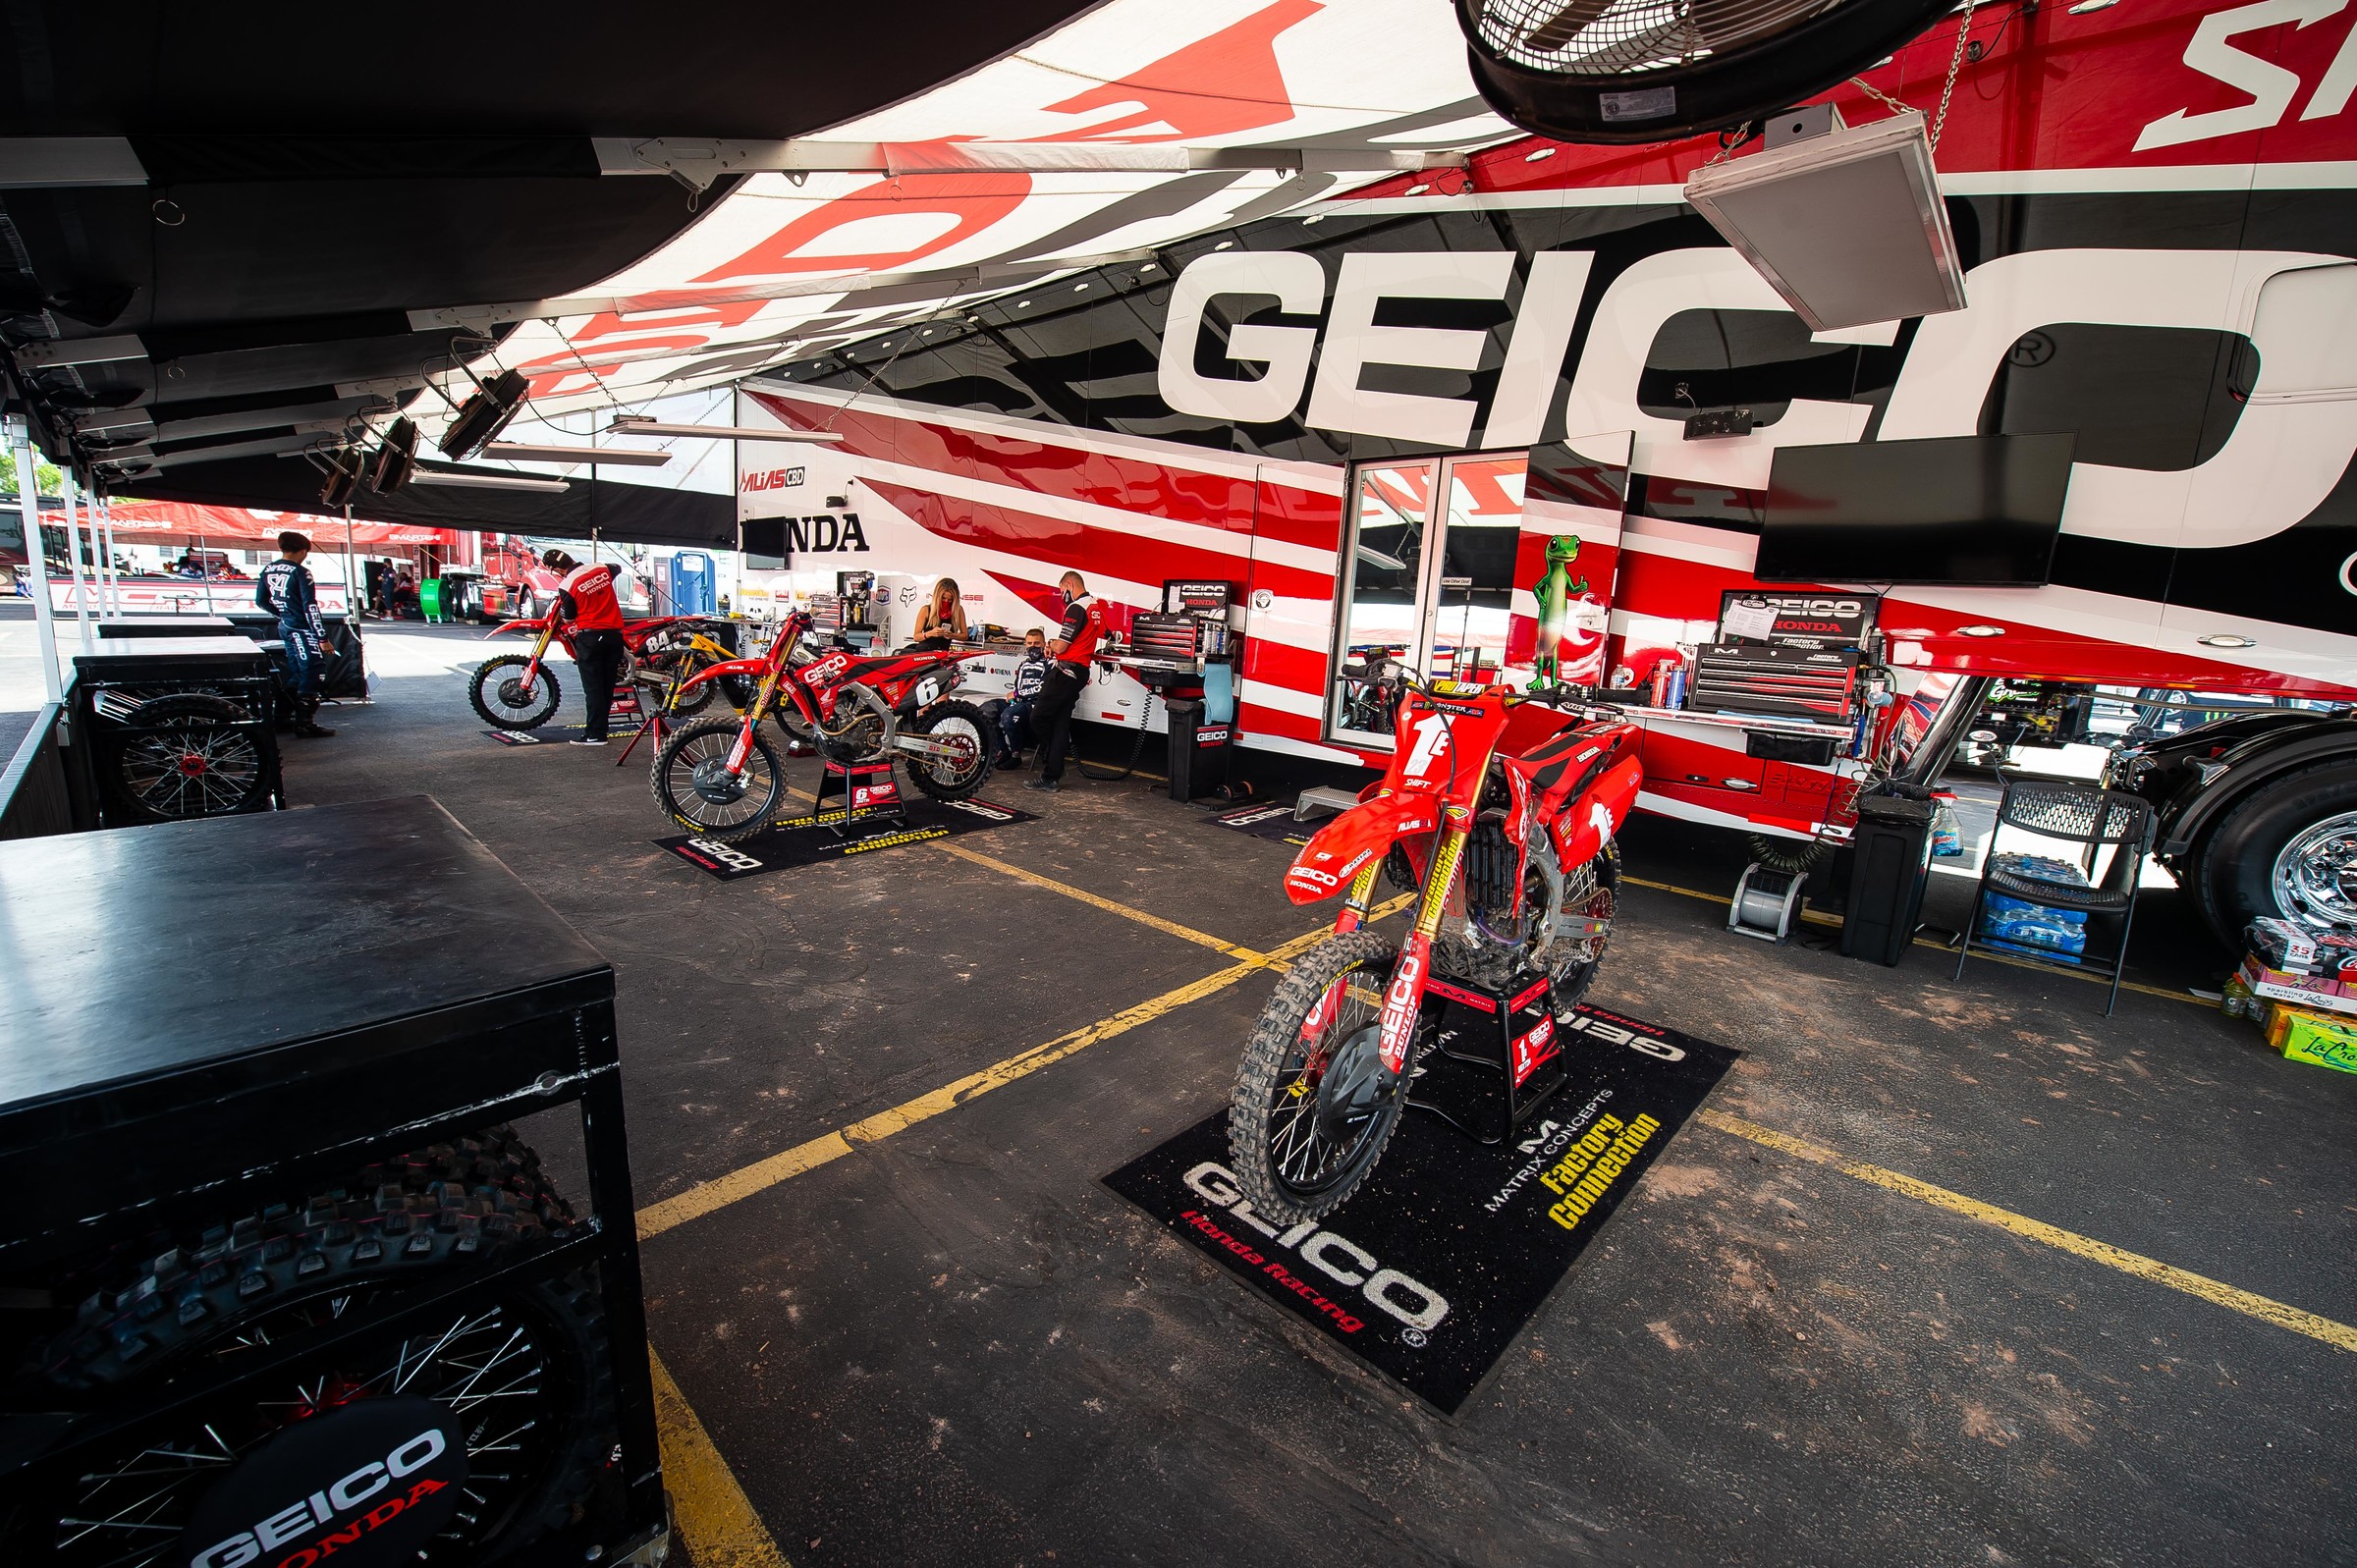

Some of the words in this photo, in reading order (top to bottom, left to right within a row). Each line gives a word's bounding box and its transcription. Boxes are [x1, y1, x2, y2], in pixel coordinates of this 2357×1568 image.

[1157, 245, 2357, 548] GEICO
[787, 468, 803, 486] CBD
[740, 513, 870, 553] NDA
[577, 571, 610, 593] GEICO
[586, 580, 611, 596] HONDA
[1180, 584, 1226, 597] GEICO
[925, 593, 984, 602] INNSE
[1185, 598, 1218, 607] HONDA
[1766, 598, 1862, 619] GEICO
[308, 603, 326, 637] GEICO
[1772, 620, 1842, 633] HONDA
[291, 631, 306, 661] GEICO
[645, 630, 670, 654] 84
[803, 655, 848, 684] GEICO
[759, 681, 776, 710] SHOWA
[915, 676, 939, 708] 6
[1561, 701, 1586, 712] ARC
[1196, 730, 1228, 742] GEICO
[856, 787, 867, 804] 6
[869, 784, 893, 794] GEICO
[1404, 778, 1433, 789] SHIFT
[1934, 835, 1954, 846] Windex
[687, 837, 763, 871] GEICO
[1289, 866, 1338, 888] GEICO
[1425, 844, 1448, 901] Factory
[1427, 837, 1460, 920] Connection
[1289, 879, 1323, 894] HONDA
[2291, 945, 2311, 955] 35
[1321, 958, 1364, 995] DUNLOP
[1469, 998, 1492, 1008] MATRIX
[2227, 997, 2237, 1005] G
[2266, 986, 2304, 998] sparkling
[2273, 992, 2295, 1000] water
[1378, 954, 1421, 1056] GEICO
[1394, 995, 1418, 1058] DUNLOP
[1528, 1020, 1551, 1044] GEICO
[1532, 1031, 1549, 1048] HONDA
[2301, 1036, 2357, 1062] LaCro
[1484, 1156, 1548, 1214] MATRIX
[1544, 1088, 1614, 1157] CONCEPTS
[1539, 1112, 1624, 1196] Factory
[1548, 1112, 1662, 1231] Connection
[1179, 1210, 1266, 1266] Honda
[1263, 1263, 1365, 1333] Racing
[190, 1428, 446, 1568] GEICO
[275, 1478, 449, 1568] ONDA
